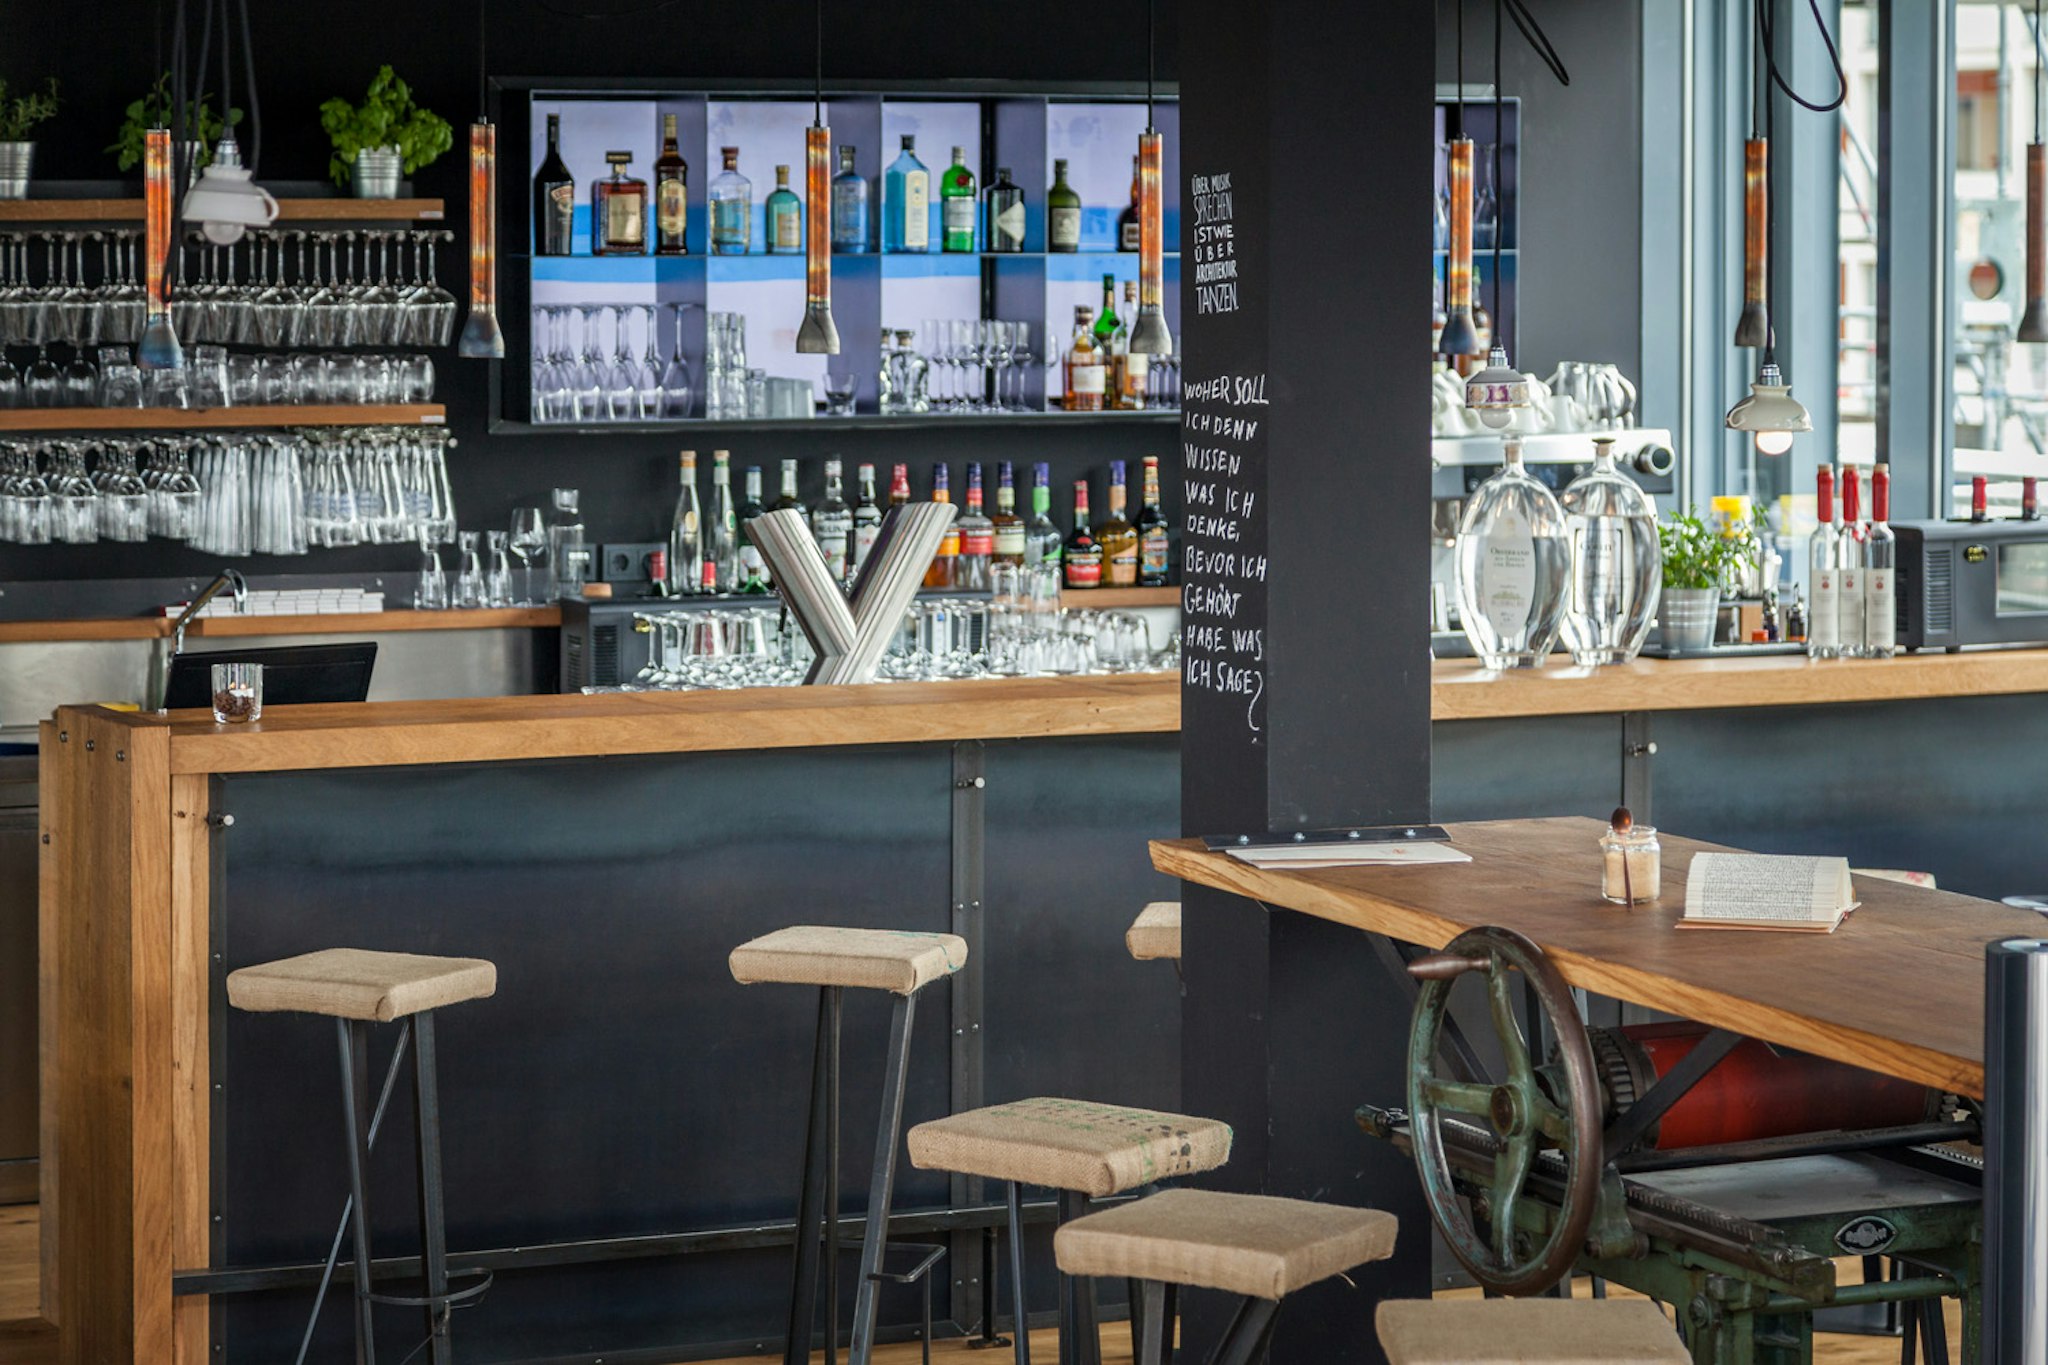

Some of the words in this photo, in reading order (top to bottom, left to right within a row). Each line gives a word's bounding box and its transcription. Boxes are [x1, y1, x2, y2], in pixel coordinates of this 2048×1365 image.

[1184, 375, 1230, 403] WOHER
[1233, 374, 1269, 406] SOLL
[1186, 411, 1210, 430] ICH
[1213, 415, 1258, 441] DENN
[1185, 443, 1241, 477] WISSEN
[1185, 480, 1216, 506] WAS
[1225, 486, 1255, 519] ICH
[1187, 514, 1241, 543] DENKE,
[1186, 545, 1235, 577] BEVOR
[1241, 554, 1267, 582] ICH
[1186, 624, 1227, 652] HABE
[1232, 629, 1263, 661] WAS
[1187, 655, 1211, 688] ICH
